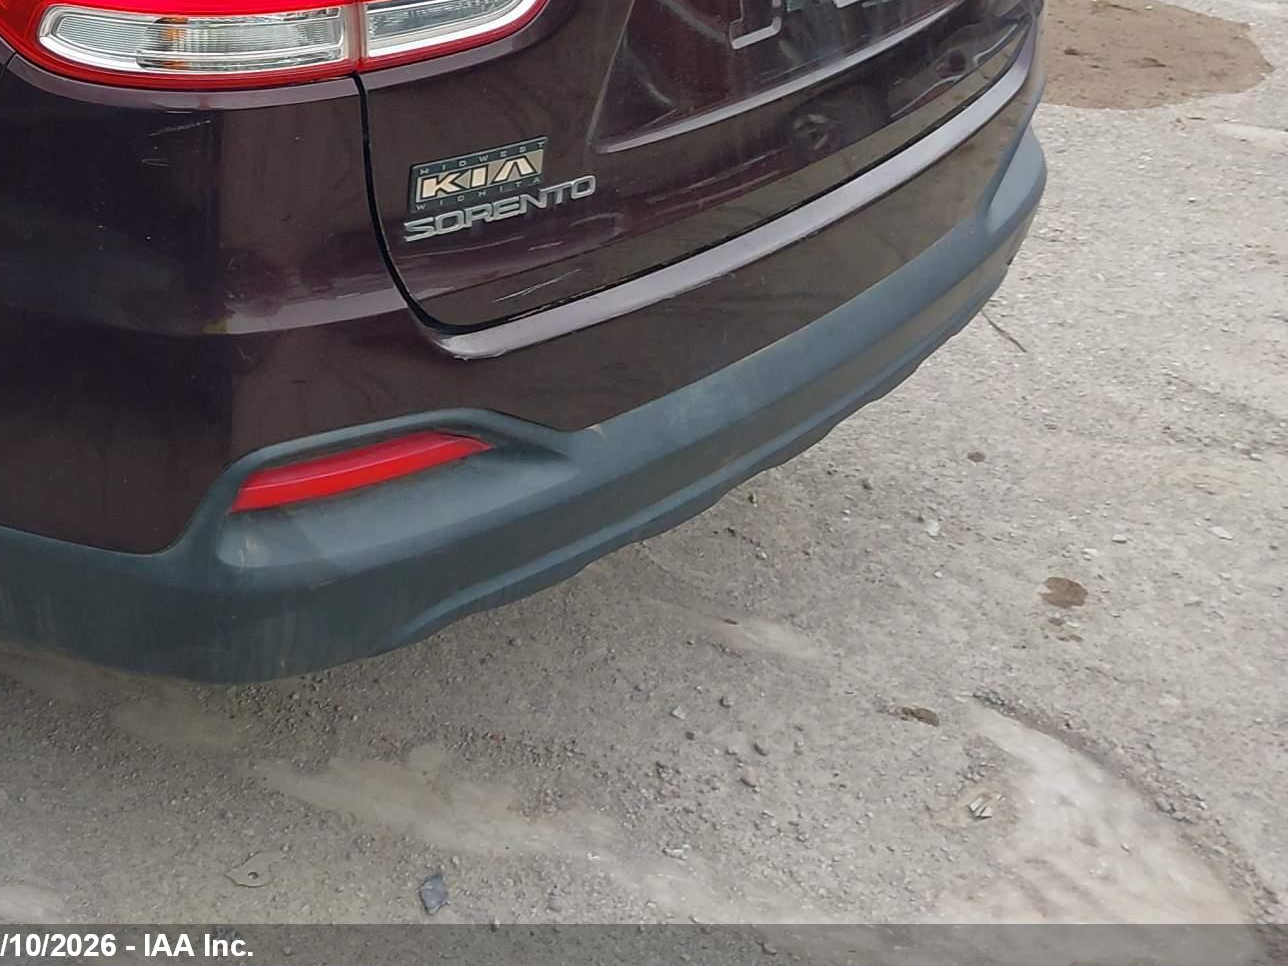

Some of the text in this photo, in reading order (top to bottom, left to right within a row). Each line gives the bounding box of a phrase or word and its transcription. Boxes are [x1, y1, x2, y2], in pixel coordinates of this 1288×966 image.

[418, 141, 545, 175] MIDWEST
[421, 155, 537, 199] KIA
[403, 175, 597, 242] SORENTO
[416, 177, 541, 211] WICHITA
